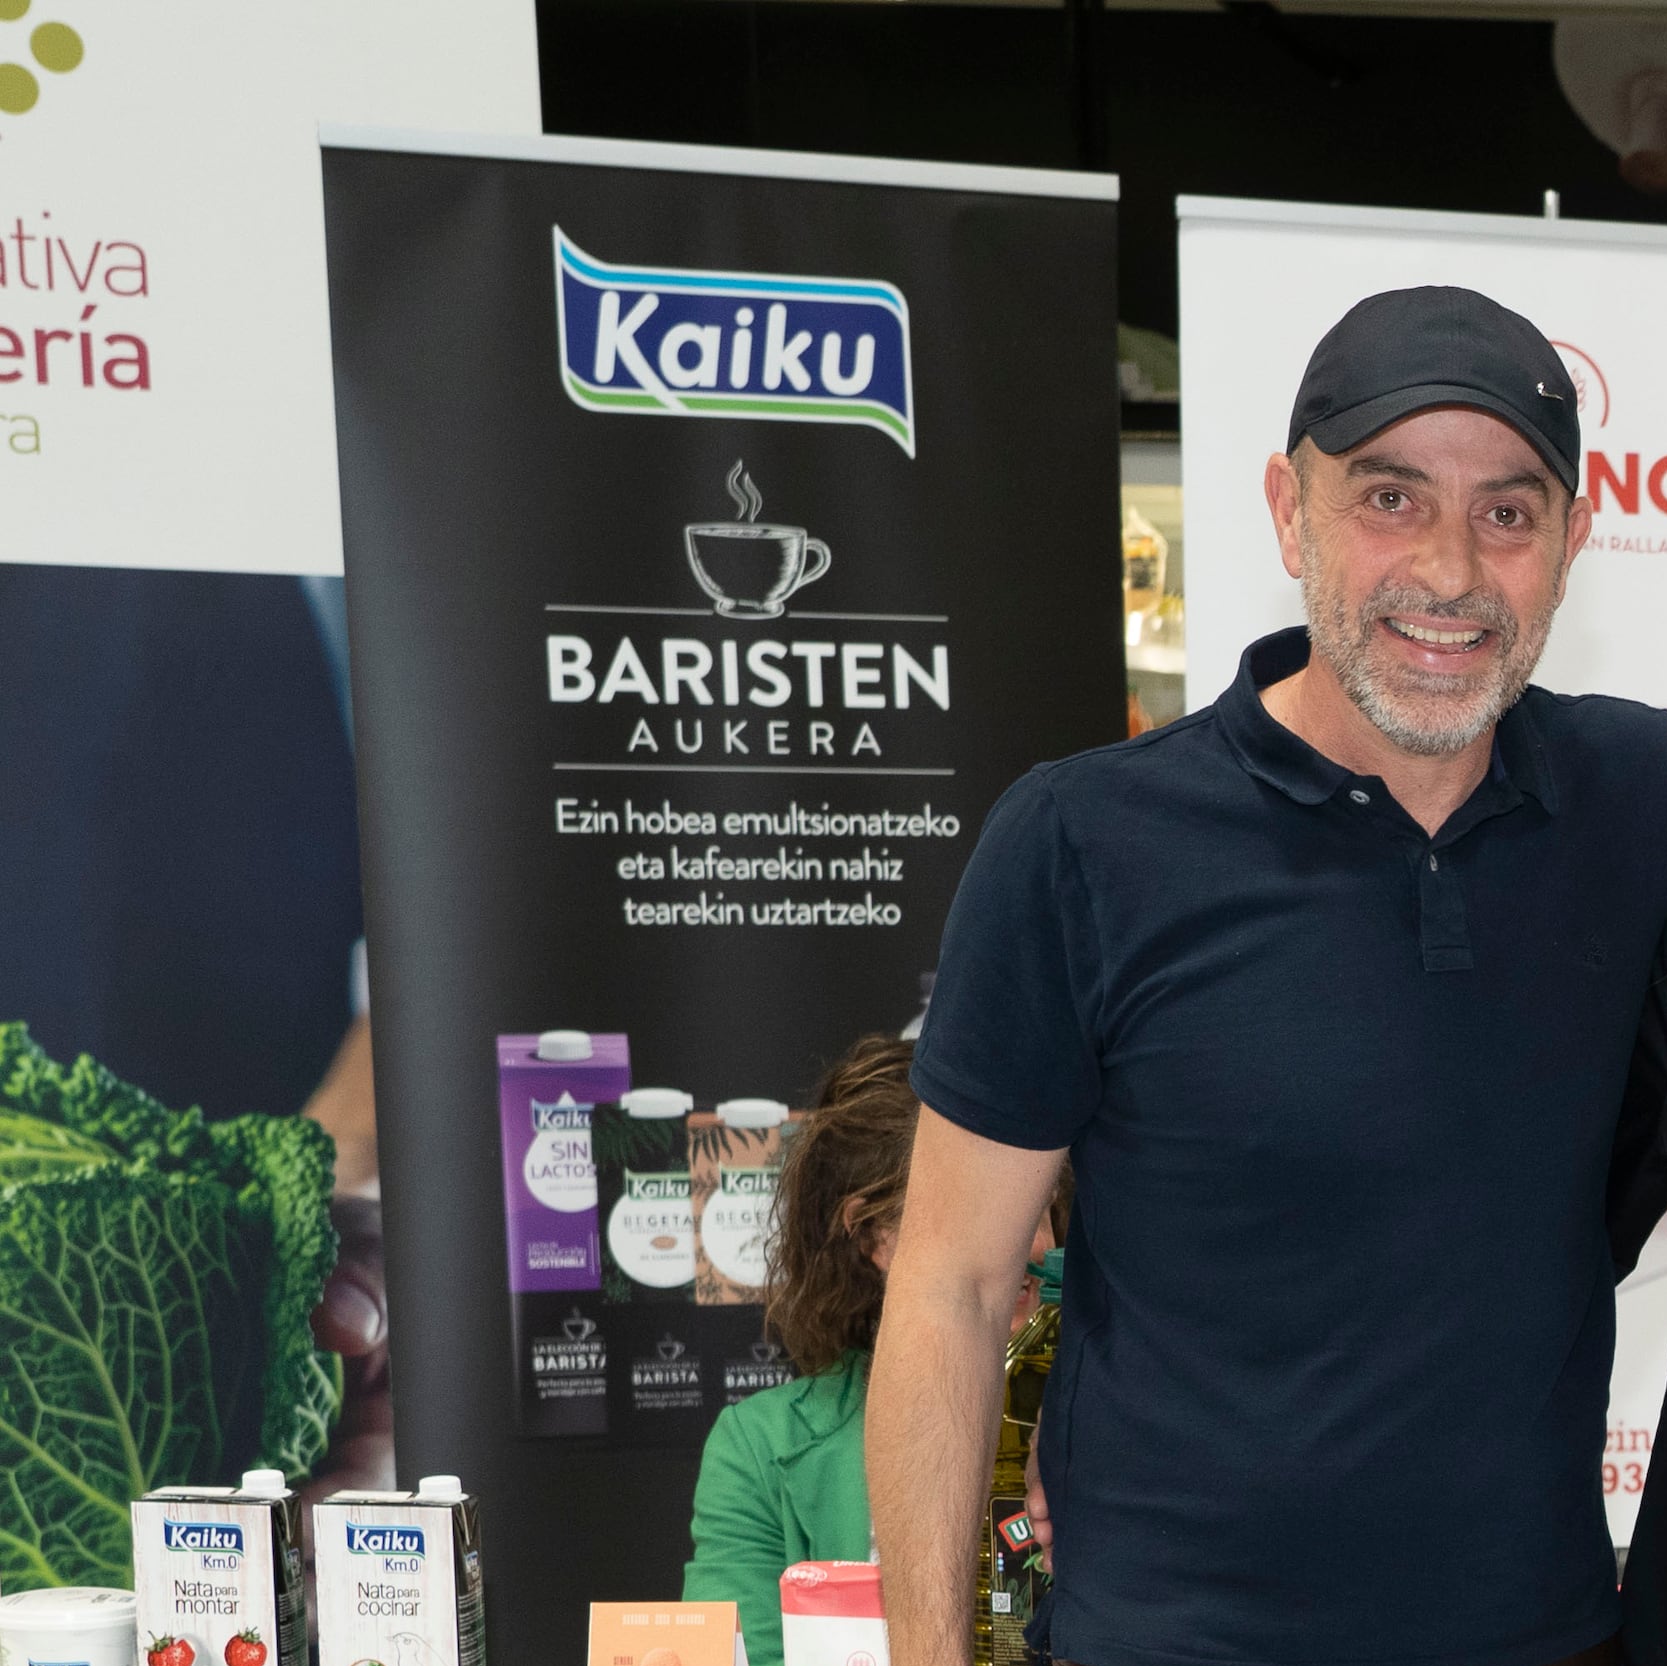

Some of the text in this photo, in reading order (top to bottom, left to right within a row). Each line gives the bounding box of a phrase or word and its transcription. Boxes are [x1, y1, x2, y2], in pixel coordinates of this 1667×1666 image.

[0, 211, 148, 298] tiva
[594, 291, 877, 410] Kaiku
[547, 634, 951, 711] BARISTEN
[628, 717, 882, 756] AUKERA
[555, 798, 961, 838] Ezin hobea emultsionatzeko
[617, 845, 904, 881] eta kafearekin nahiz
[623, 892, 901, 926] tearekin uztartzeko
[552, 1142, 588, 1161] SIN
[631, 1179, 690, 1198] Kaiku
[170, 1525, 237, 1551] Kaiku
[352, 1529, 419, 1553] Kaiku
[203, 1555, 238, 1570] Km.0
[385, 1558, 419, 1572] Km.0
[174, 1580, 238, 1598] Nata para
[357, 1582, 421, 1600] Nata para
[175, 1599, 240, 1617] montar
[357, 1600, 421, 1617] cocinar
